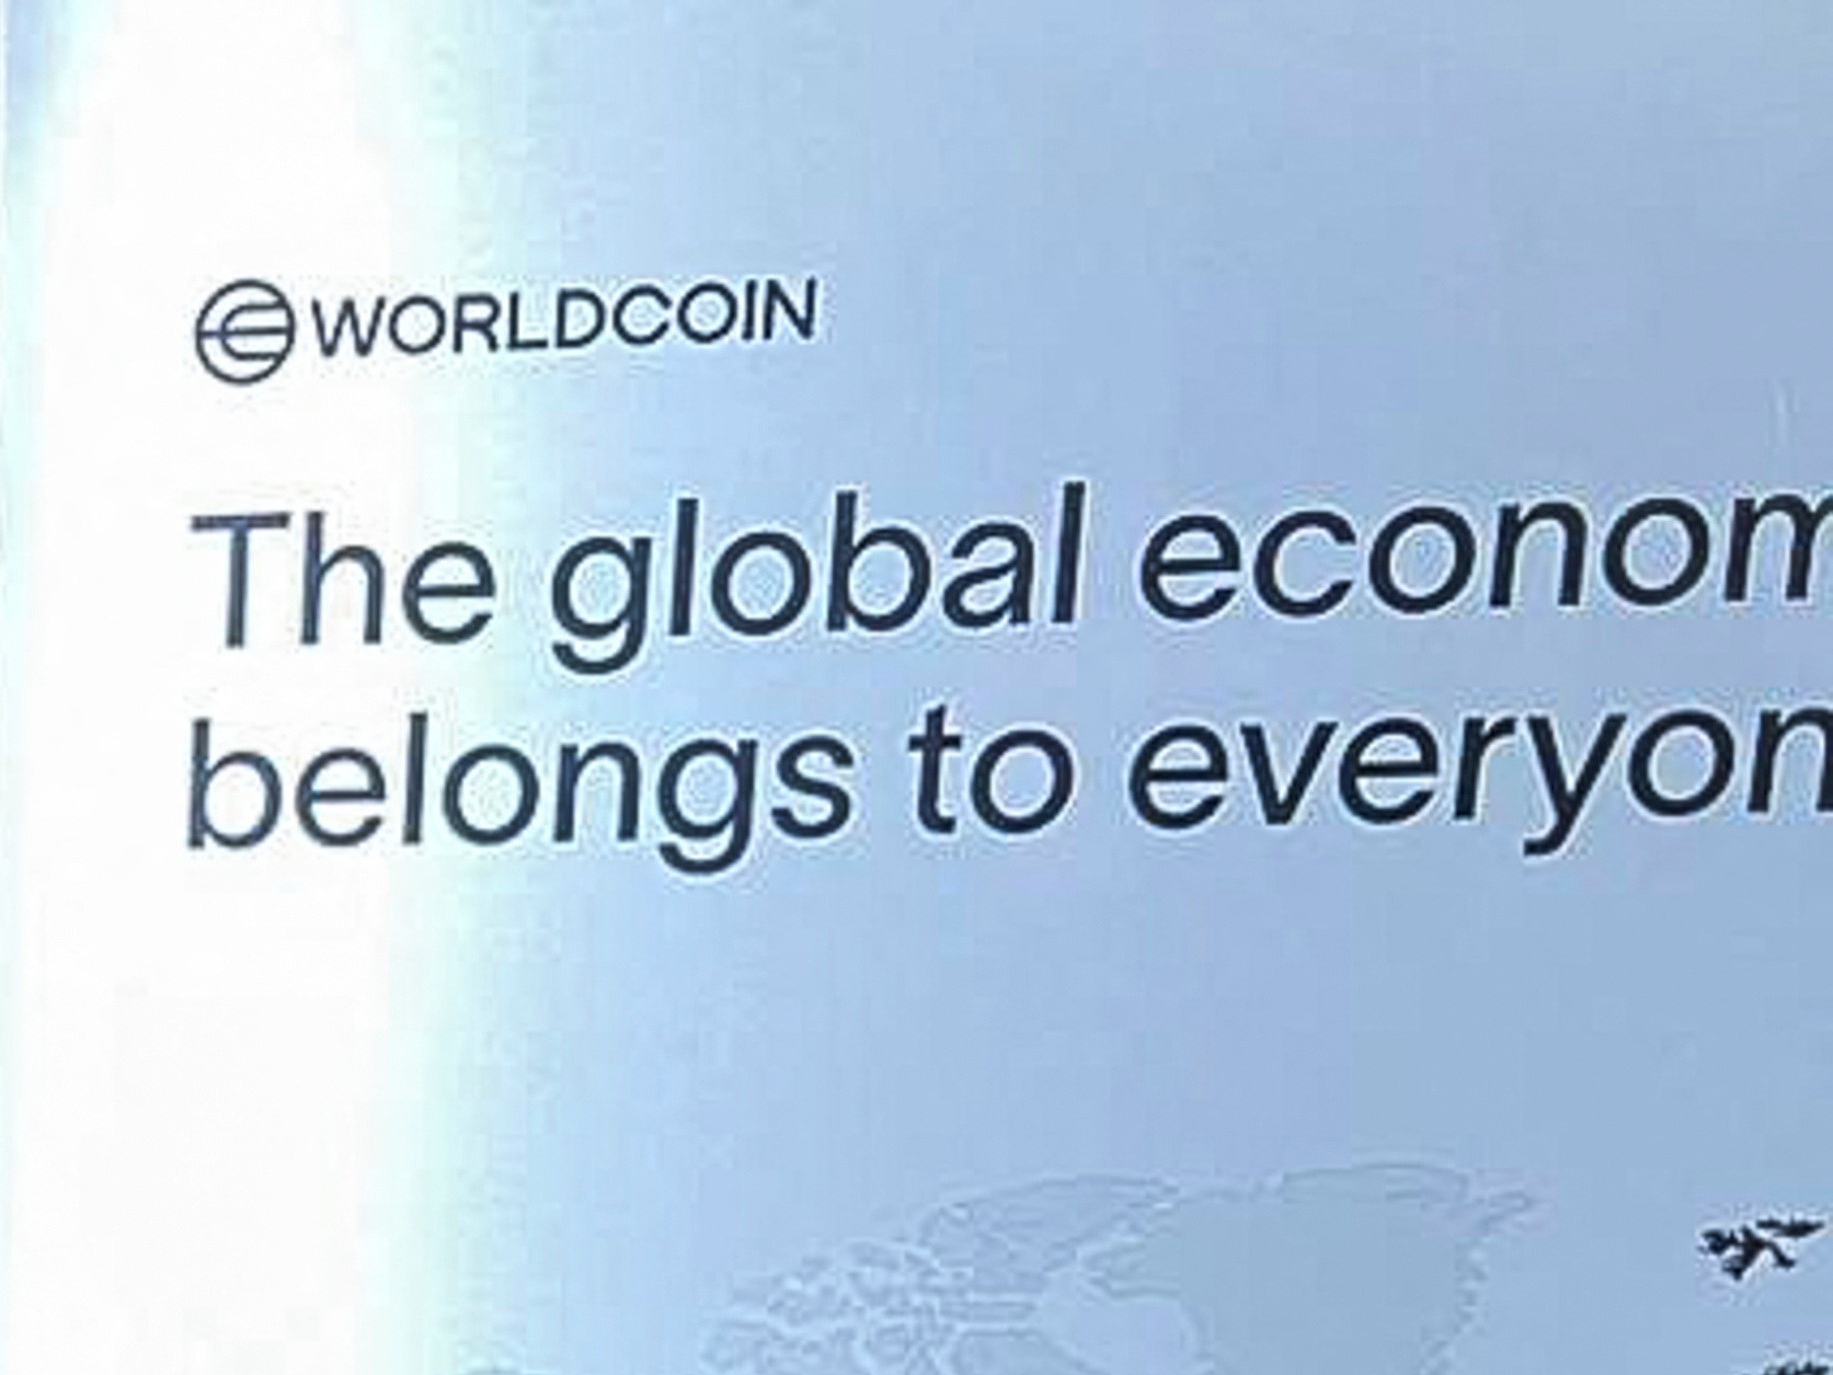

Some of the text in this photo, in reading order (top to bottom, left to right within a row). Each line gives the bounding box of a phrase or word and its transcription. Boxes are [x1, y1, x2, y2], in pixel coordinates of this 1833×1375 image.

[312, 278, 817, 358] WORLDCOIN
[189, 480, 1833, 676] The global econom
[185, 704, 1833, 875] belongs to everyon
